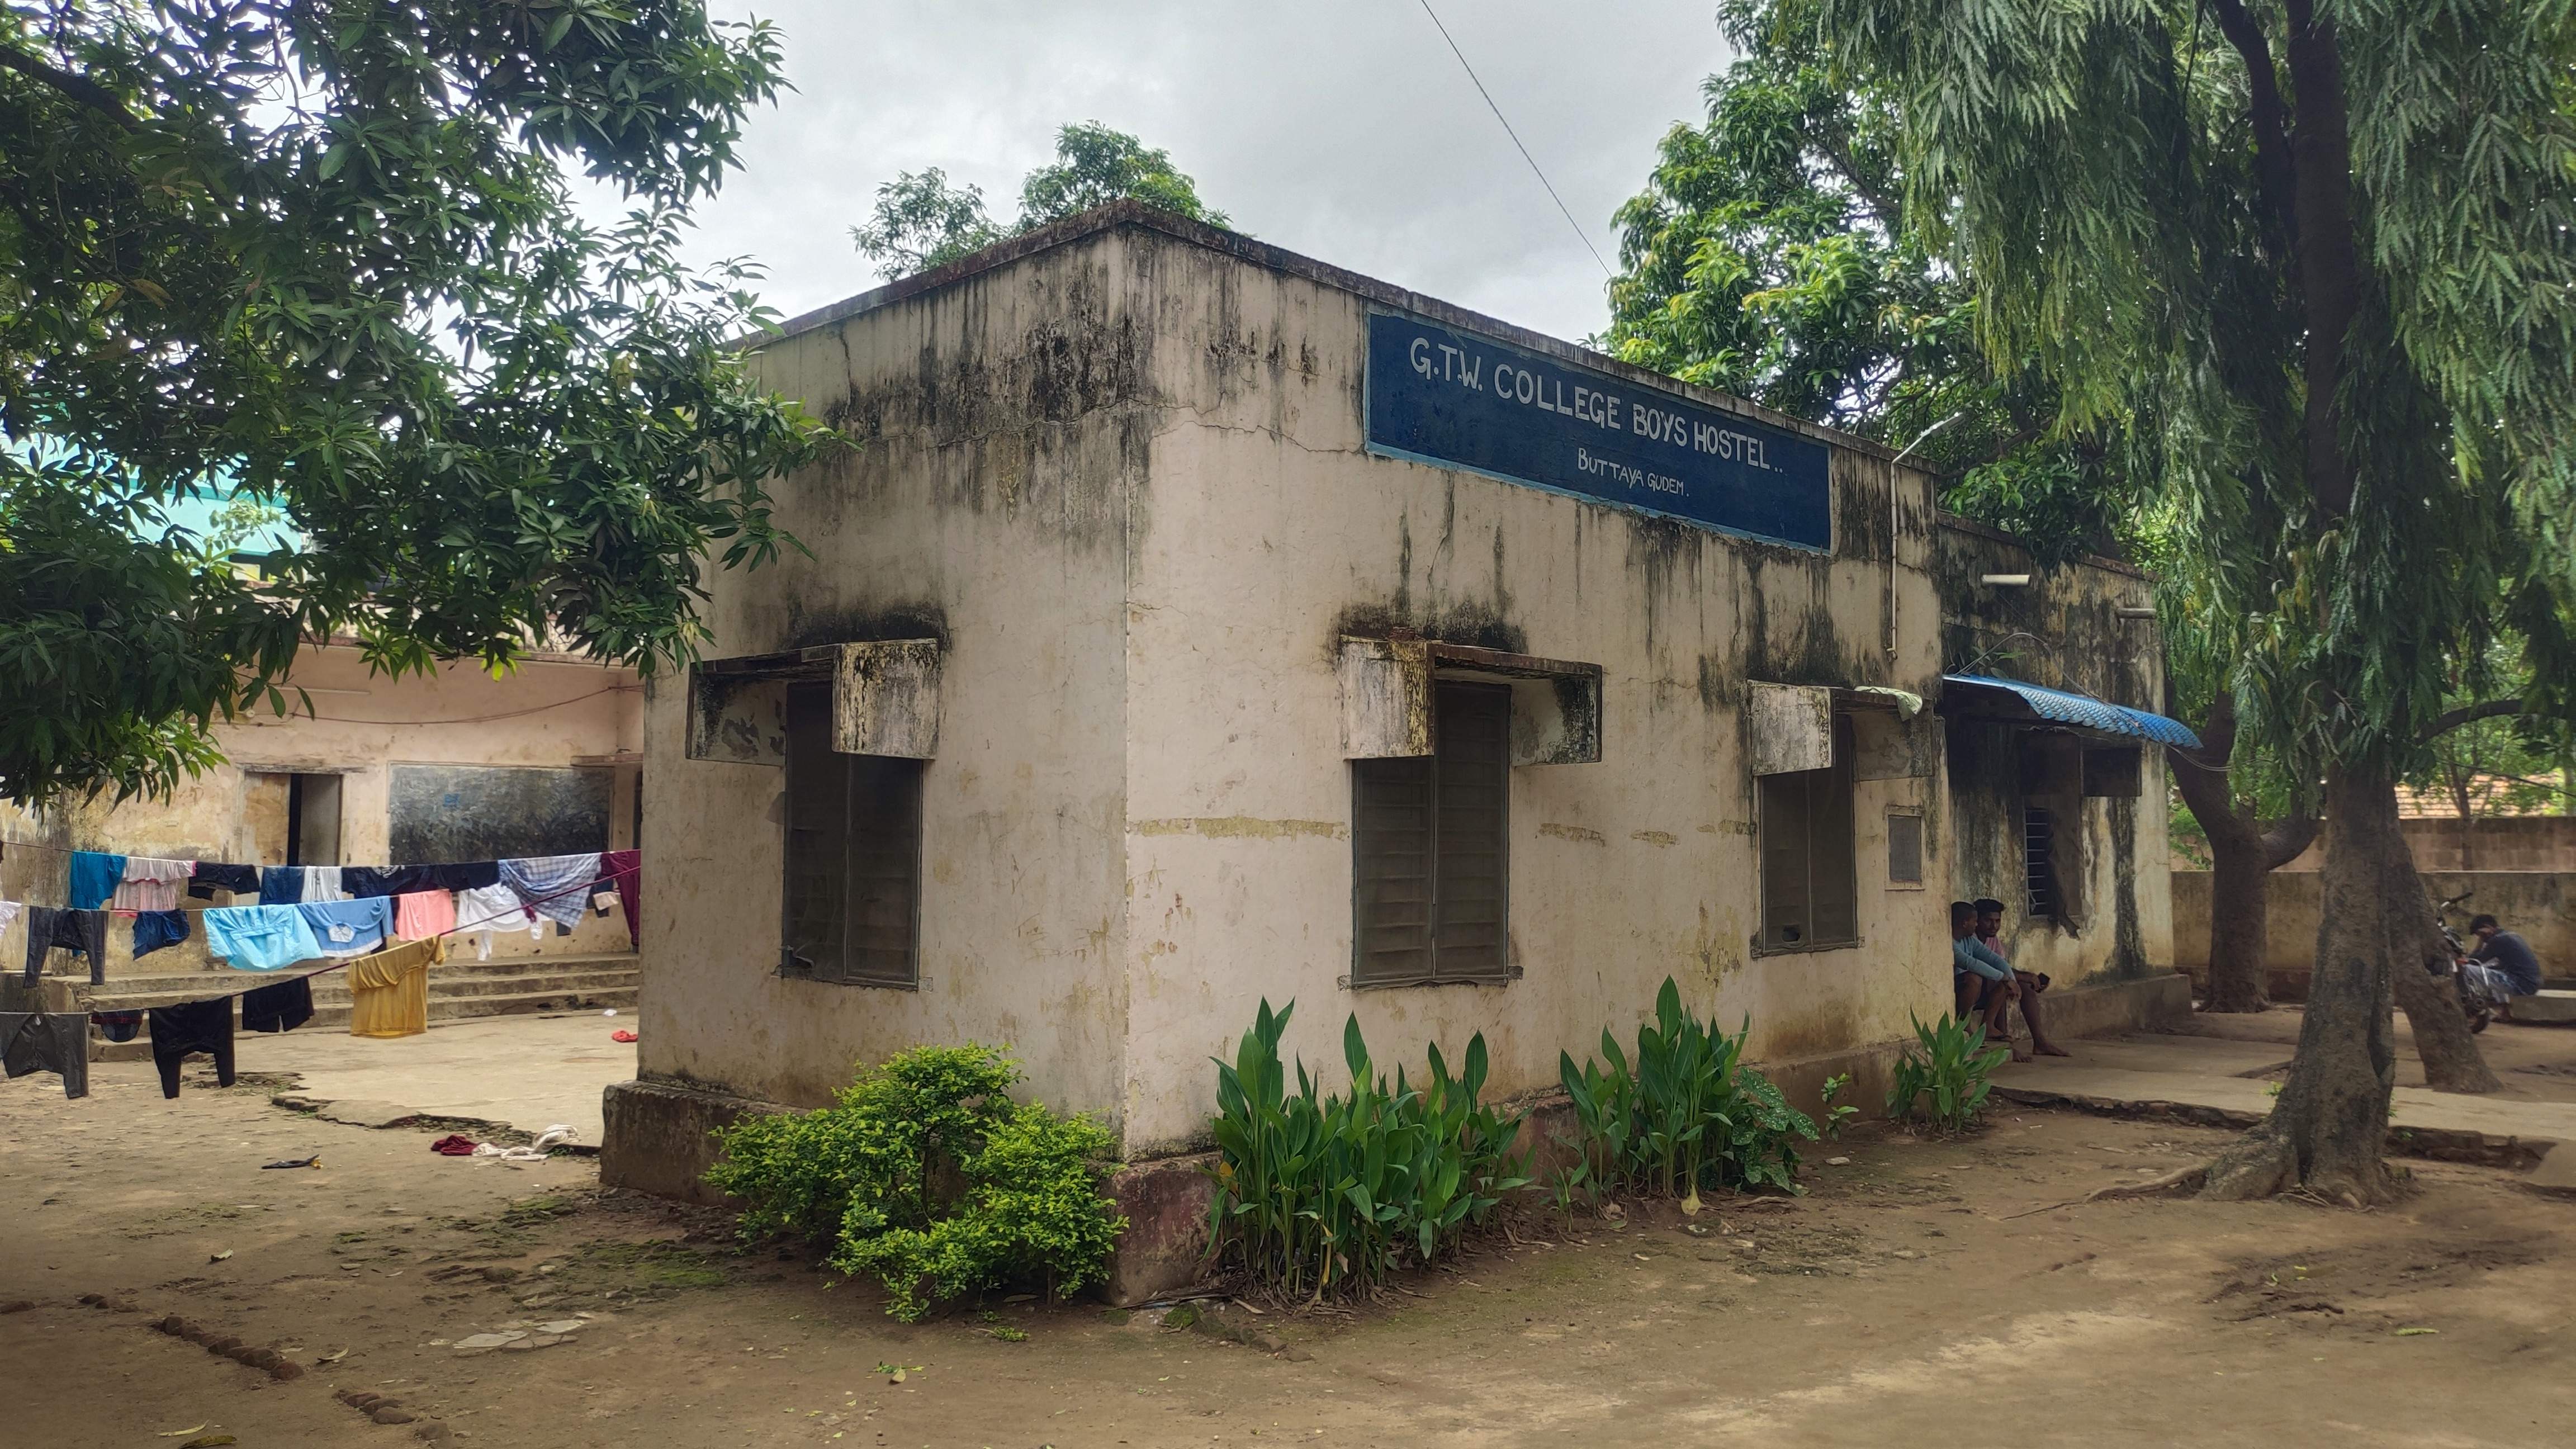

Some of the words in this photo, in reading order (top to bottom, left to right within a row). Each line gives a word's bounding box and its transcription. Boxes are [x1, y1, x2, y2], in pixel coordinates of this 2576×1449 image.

[1410, 337, 1483, 392] G.T.W.
[1494, 363, 1621, 429] COLLEGE
[1633, 403, 1687, 447] BOYS
[1578, 447, 1644, 489] BUTTAYA
